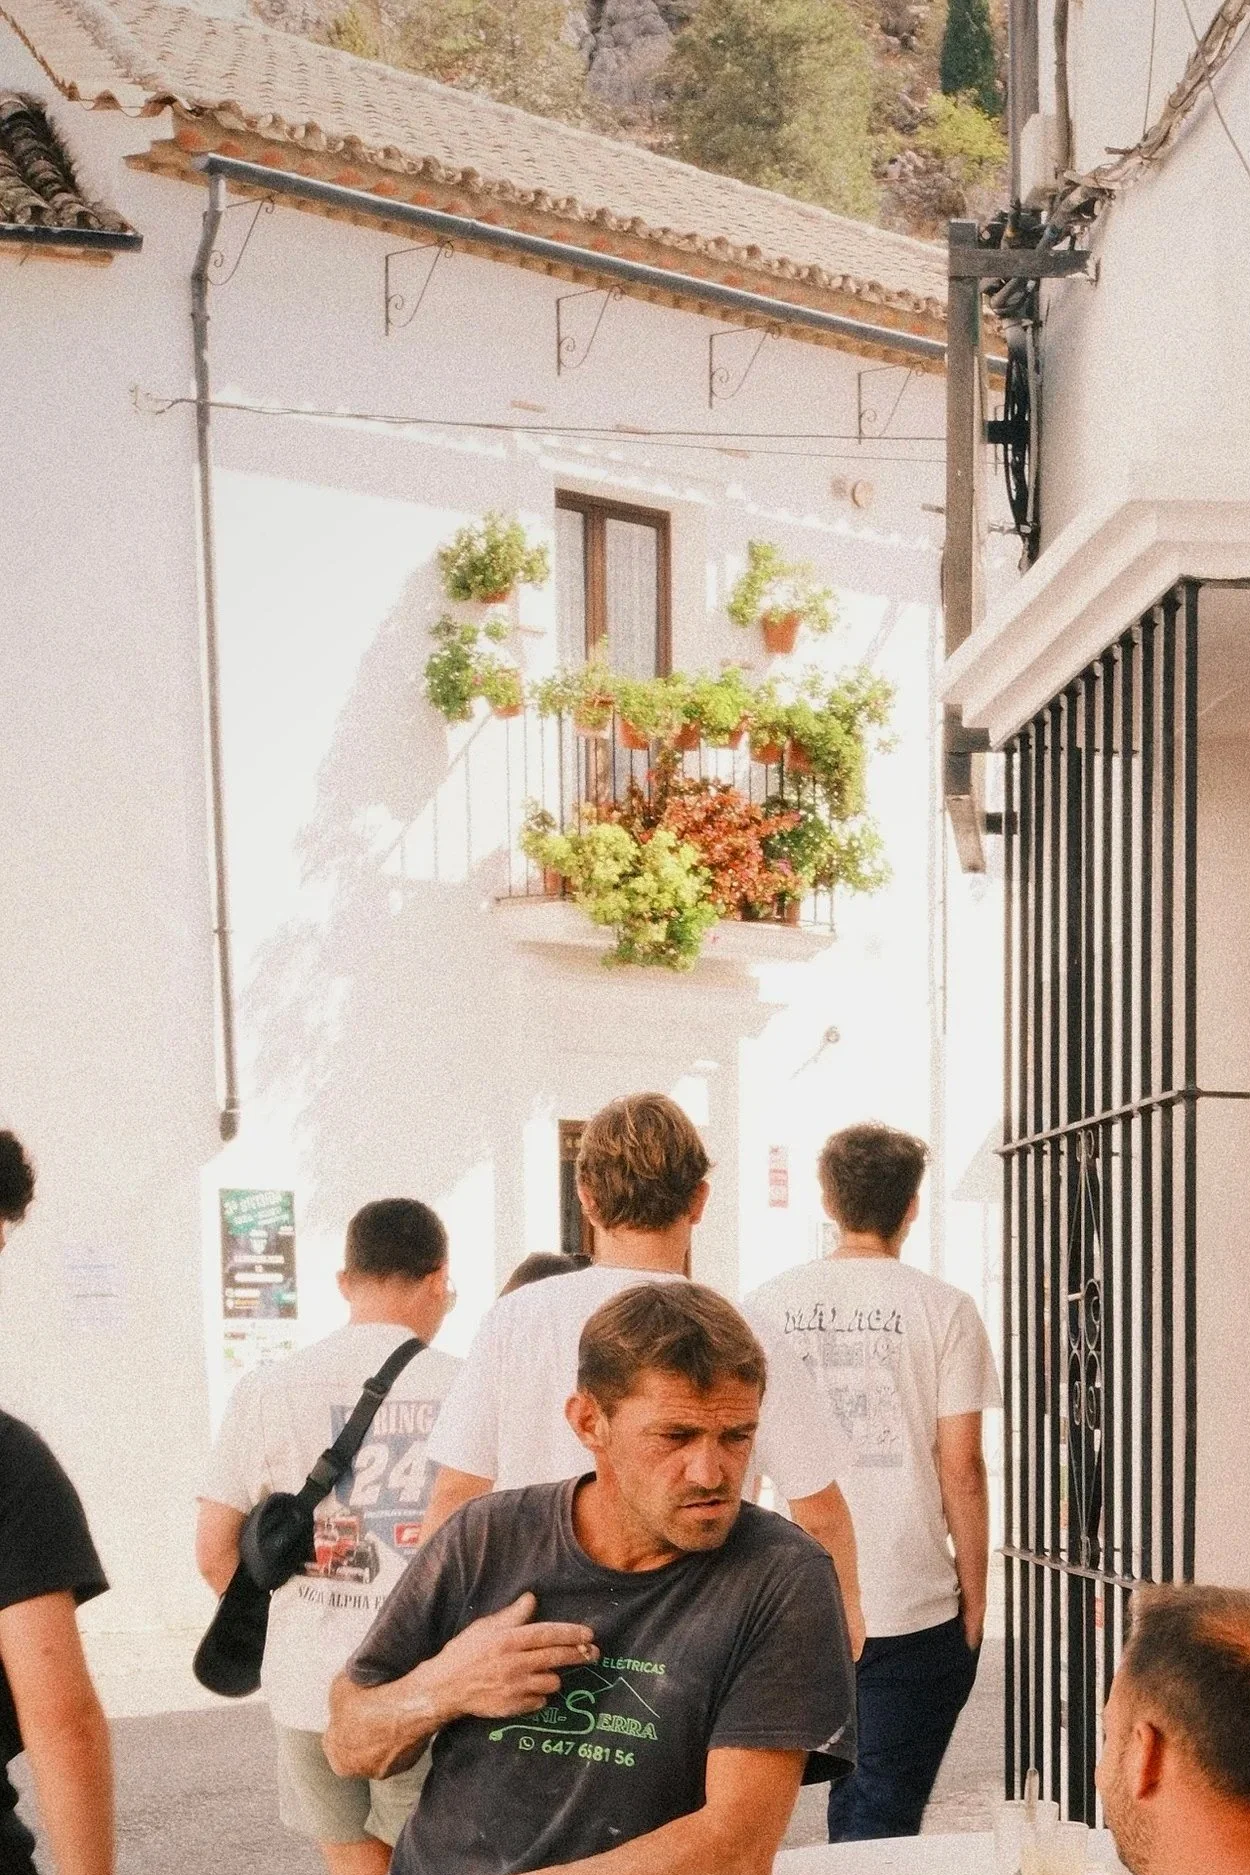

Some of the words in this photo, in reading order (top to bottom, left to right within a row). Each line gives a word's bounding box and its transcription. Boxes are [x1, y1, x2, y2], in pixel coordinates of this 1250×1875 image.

[350, 1442, 429, 1505] 24
[541, 1739, 576, 1756] 647
[614, 1749, 636, 1768] 56
